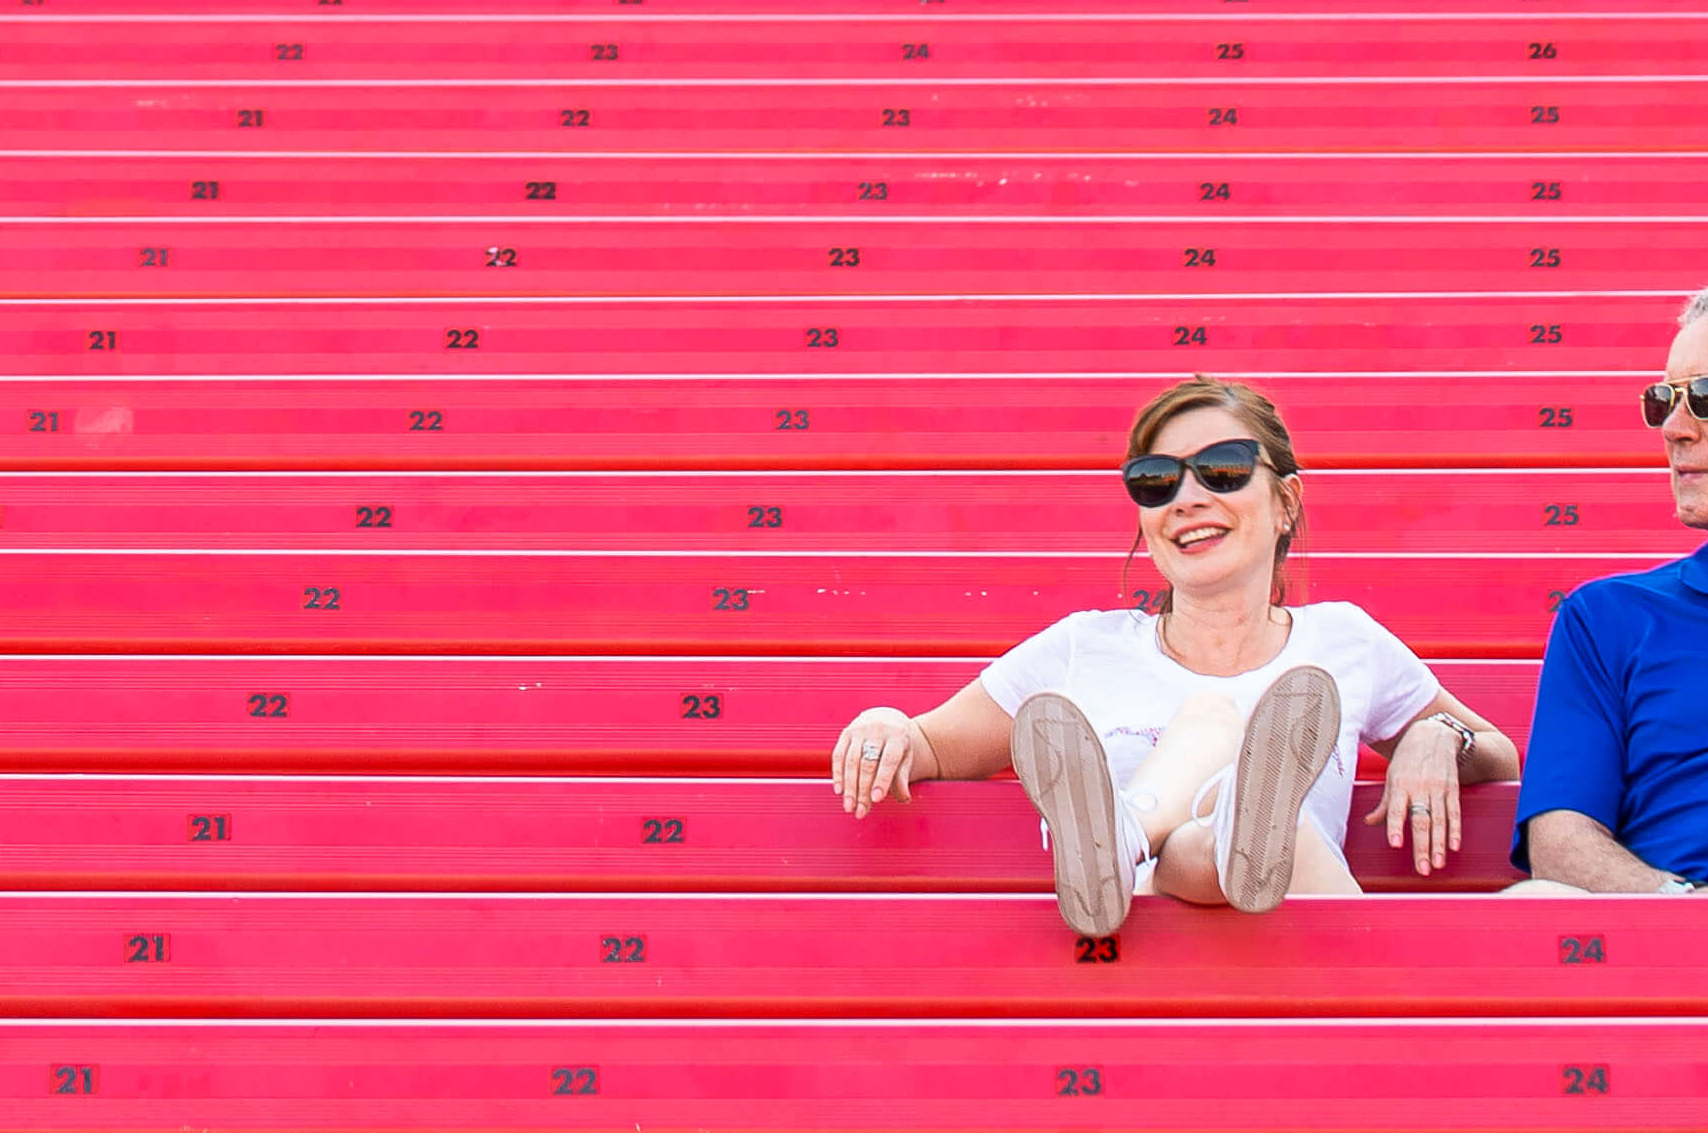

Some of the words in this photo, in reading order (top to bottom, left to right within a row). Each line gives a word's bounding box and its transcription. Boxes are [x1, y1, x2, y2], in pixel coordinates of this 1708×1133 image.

[1217, 43, 1243, 59] 25
[1529, 43, 1556, 59] 26
[239, 110, 262, 127] 21
[562, 110, 589, 126] 22
[883, 109, 910, 127] 23
[1209, 108, 1237, 125] 24
[1531, 107, 1559, 123] 25
[192, 181, 218, 199] 21
[526, 182, 555, 200] 22
[859, 182, 888, 200] 23
[1201, 183, 1230, 200] 24
[1533, 182, 1561, 200] 25
[142, 248, 167, 267] 21
[486, 248, 516, 267] 22
[829, 248, 859, 267] 23
[1185, 249, 1215, 267] 24
[1531, 249, 1560, 267] 25
[89, 331, 115, 350] 21
[447, 330, 478, 349] 22
[807, 328, 838, 347] 23
[1175, 326, 1207, 345] 24
[1531, 325, 1562, 343] 25
[31, 411, 58, 432] 21
[410, 411, 442, 431] 22
[777, 410, 809, 430] 23
[1540, 408, 1572, 427] 25
[357, 507, 391, 528] 22
[748, 507, 782, 528] 23
[1545, 505, 1579, 525] 25
[304, 587, 339, 610] 22
[713, 589, 749, 611] 23
[1548, 590, 1567, 613] 2
[249, 694, 286, 718] 22
[683, 695, 720, 719] 23
[193, 817, 225, 841] 21
[644, 819, 683, 843] 22
[129, 935, 163, 962] 21
[603, 937, 643, 963] 22
[1077, 937, 1119, 963] 23
[1563, 938, 1603, 963] 24
[57, 1067, 91, 1094] 21
[554, 1068, 596, 1095] 22
[1059, 1069, 1101, 1095] 23
[1564, 1067, 1607, 1094] 24
